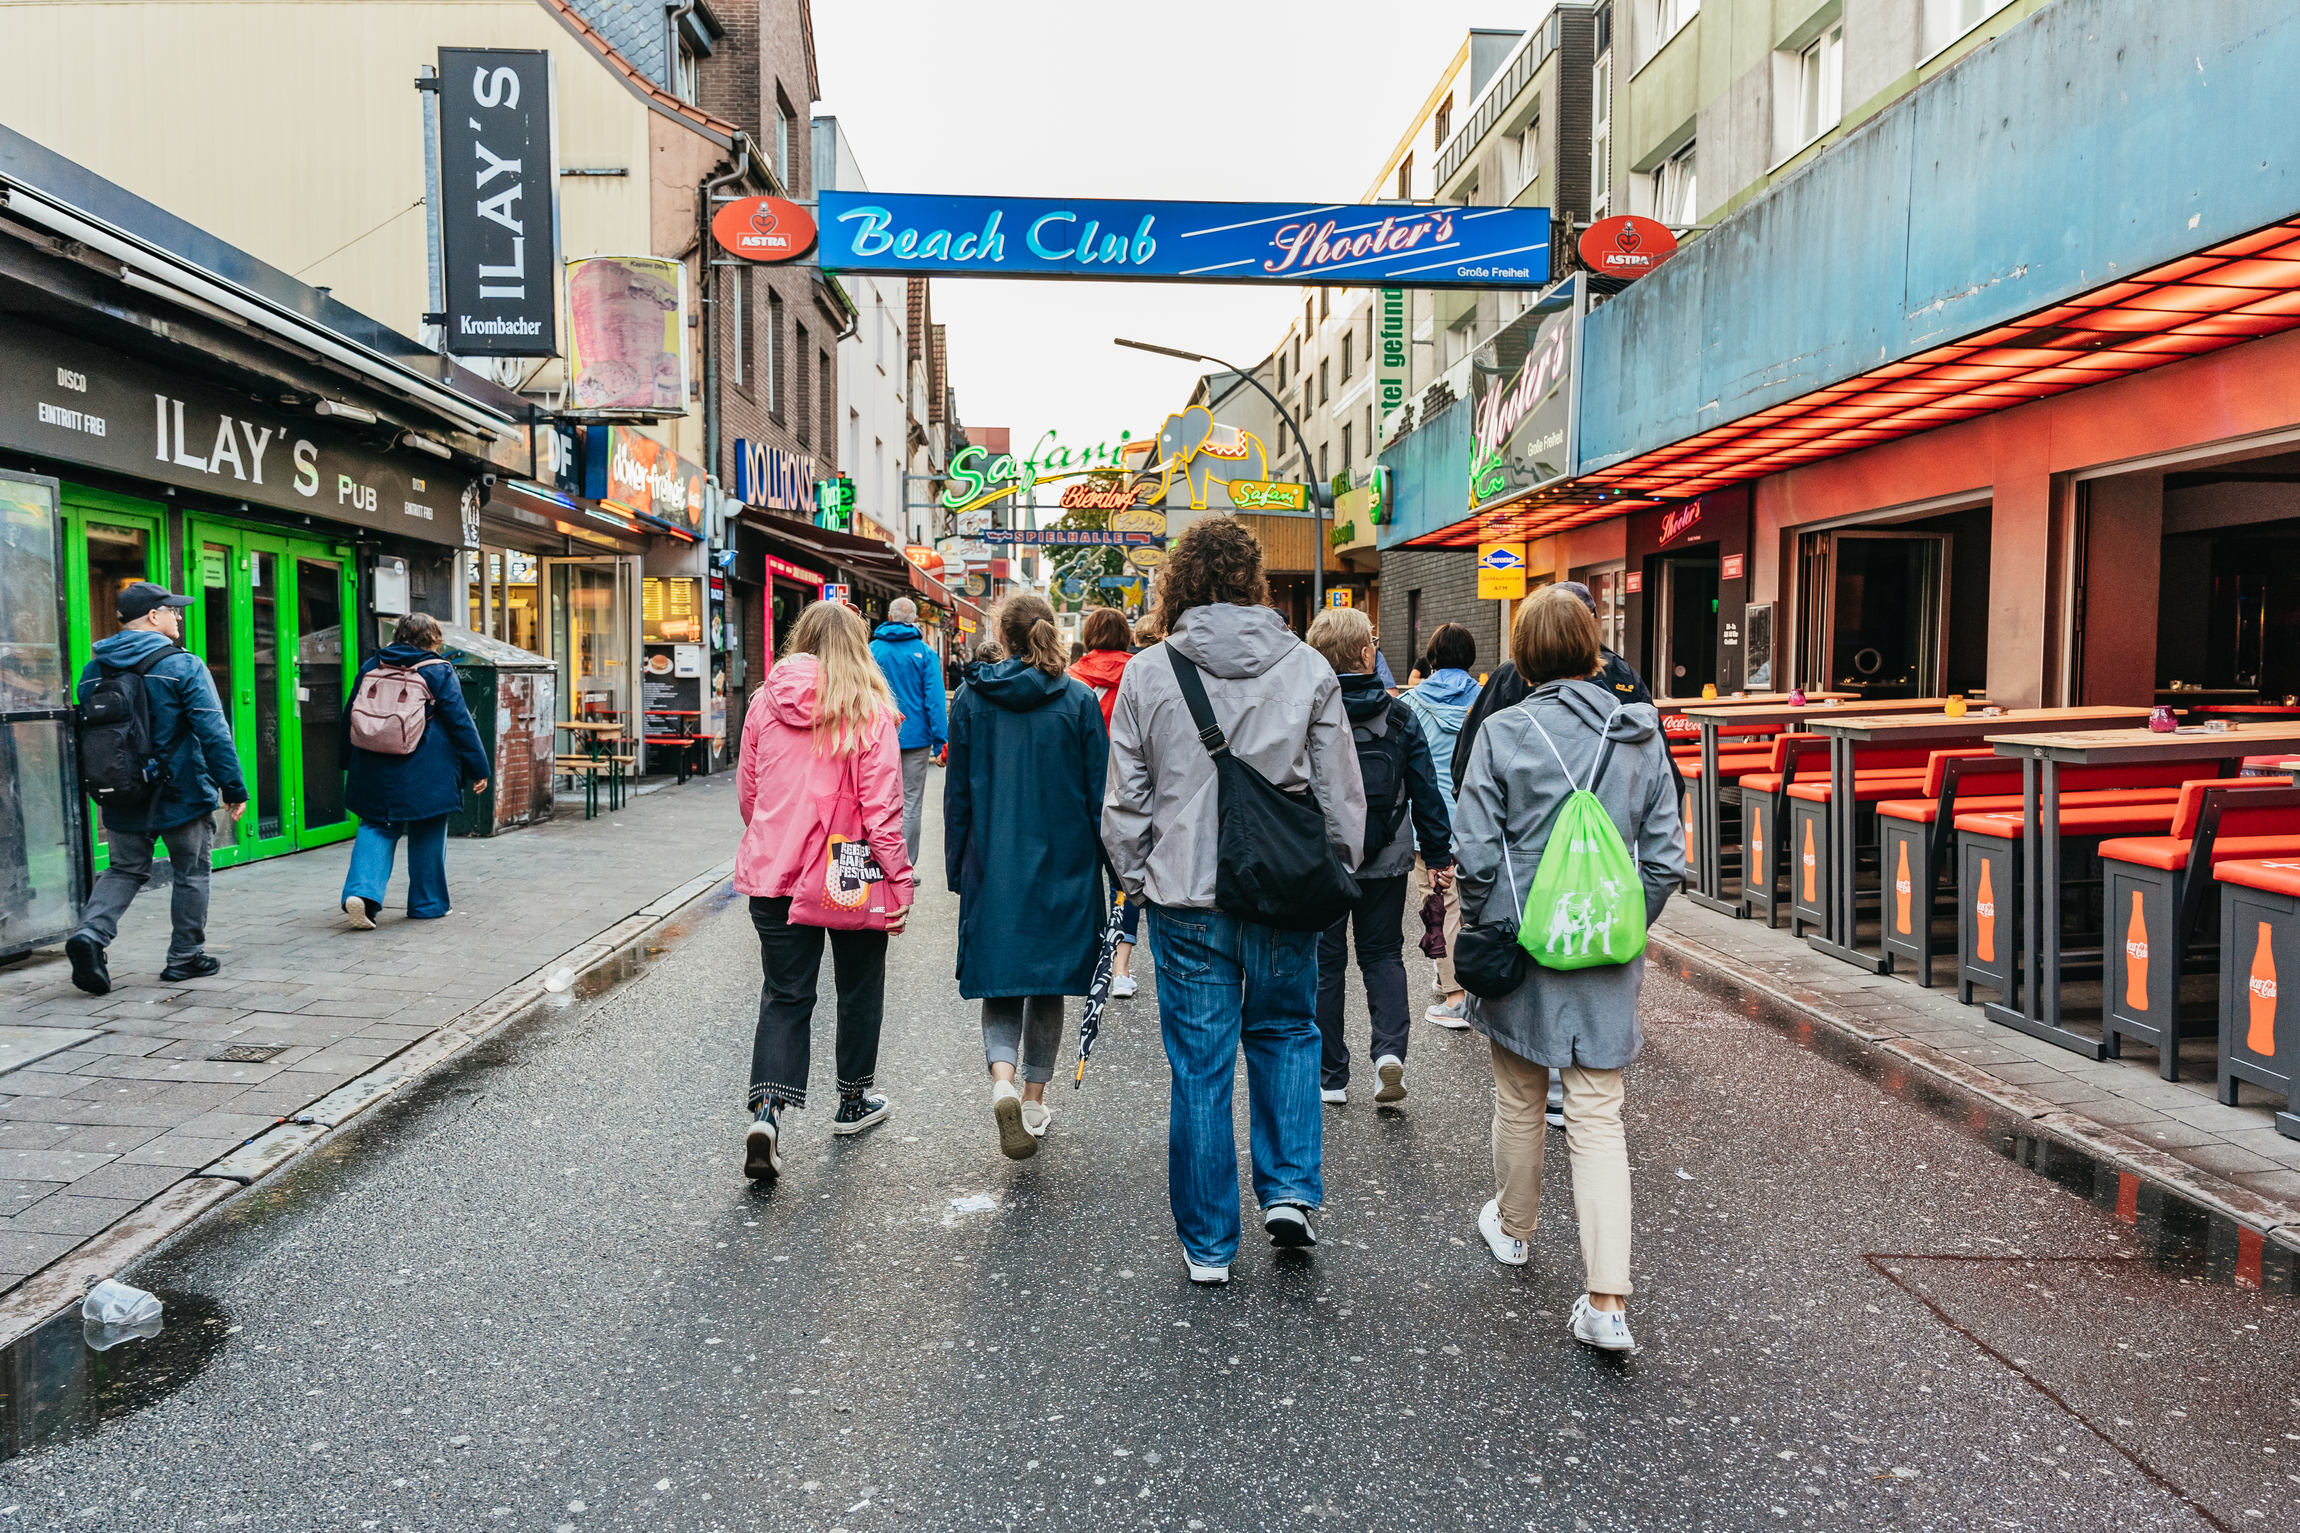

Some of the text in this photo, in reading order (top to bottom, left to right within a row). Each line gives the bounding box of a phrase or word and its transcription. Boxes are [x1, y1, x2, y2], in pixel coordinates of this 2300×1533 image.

[469, 65, 526, 300] ILAY'S
[741, 236, 787, 247] ASTRA
[836, 205, 1157, 265] Beach Club
[1263, 211, 1455, 272] Shooter's
[1457, 266, 1530, 279] Große Freiheit
[1605, 254, 1649, 265] ASTRA
[460, 315, 542, 336] Krombacher
[57, 367, 87, 393] DISCO
[1471, 325, 1566, 476] Shooter's
[38, 401, 106, 437] EINTRITT FREI
[155, 393, 378, 512] ILAY'S PUB
[547, 427, 573, 477] DF
[1527, 429, 1564, 457] Große Freiheit
[745, 437, 818, 512] DOLLHOUSE
[942, 429, 1131, 508] Safari
[1059, 482, 1143, 514] Bierdorf
[1233, 482, 1299, 507] Safari
[1116, 513, 1164, 532] Colibri
[1659, 501, 1701, 543] Shooter's
[1014, 530, 1123, 544] SPIELHALLE
[912, 553, 927, 566] 23
[1486, 555, 1516, 564] Euronet
[840, 866, 884, 880] FESTIVAL
